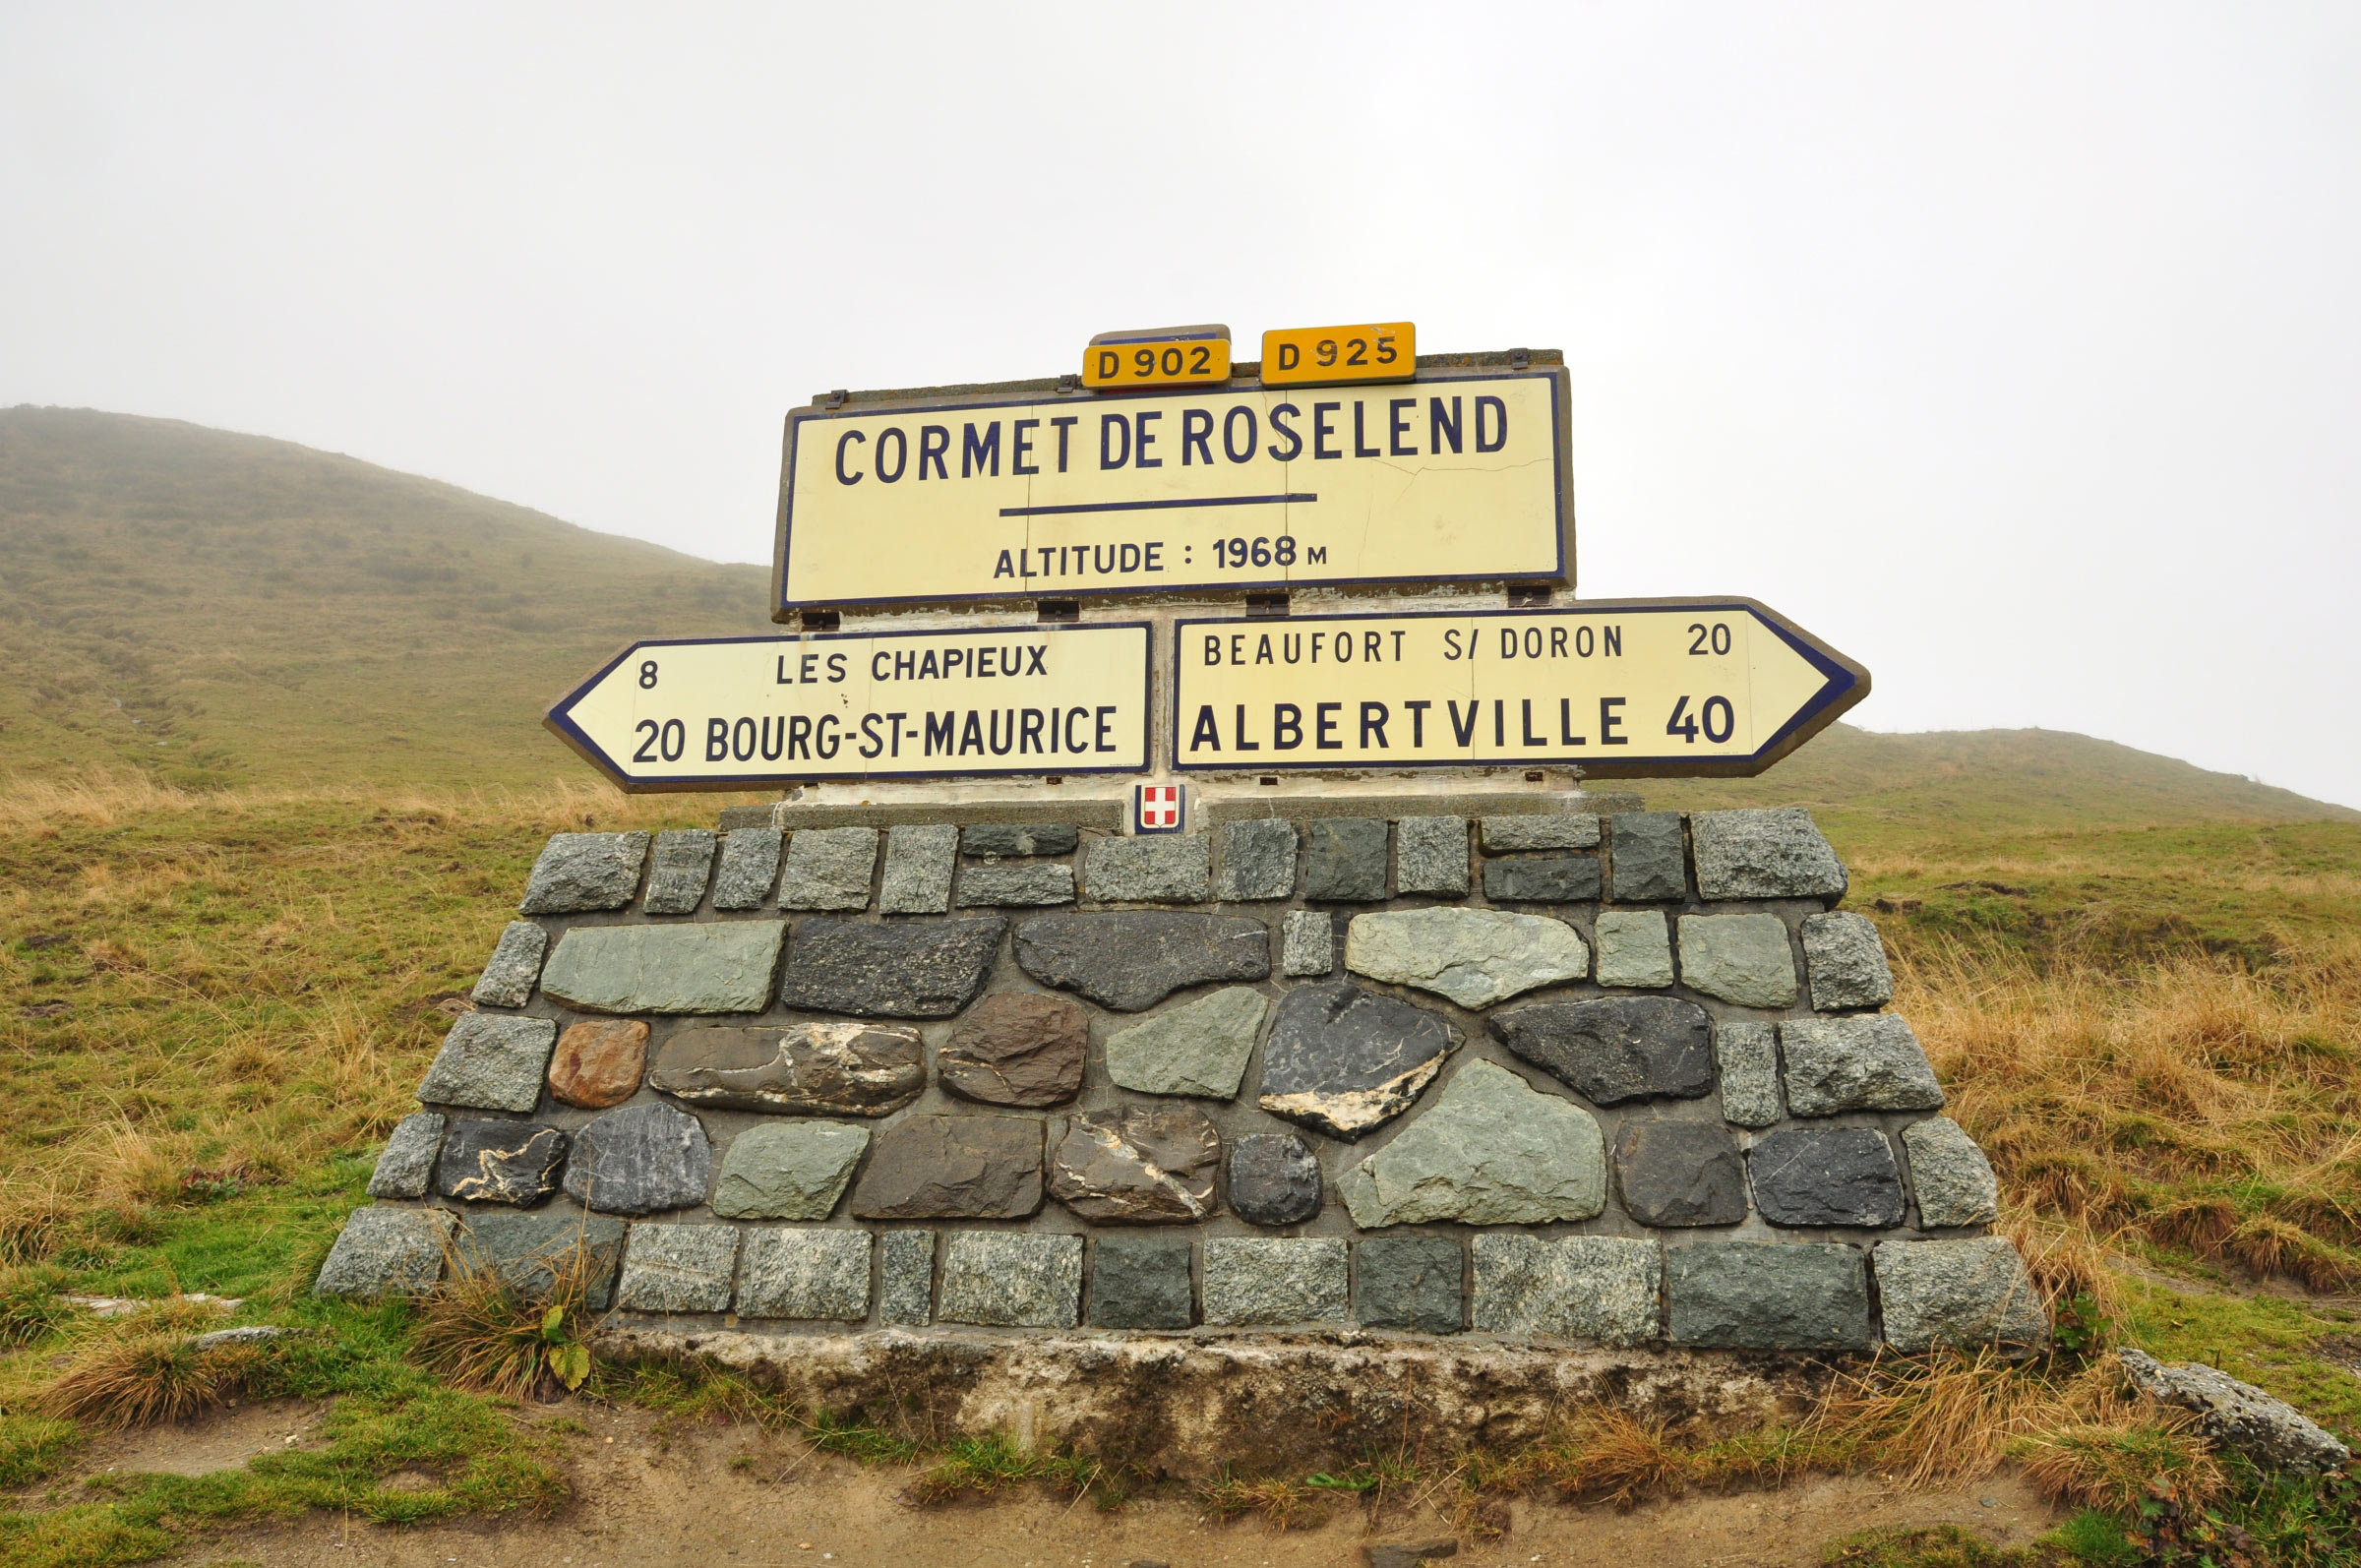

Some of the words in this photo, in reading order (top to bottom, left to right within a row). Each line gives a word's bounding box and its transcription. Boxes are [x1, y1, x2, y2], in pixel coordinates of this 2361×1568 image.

[1099, 351, 1120, 380] D
[1134, 345, 1211, 378] 902
[1278, 343, 1300, 371] D
[1316, 335, 1398, 367] 925
[835, 415, 1078, 486] CORMET
[1100, 410, 1163, 470] DE
[1181, 395, 1508, 466] ROSELEND
[994, 542, 1164, 578] ALTITUDE
[1212, 535, 1297, 569] 1968
[1307, 546, 1327, 566] M
[1204, 631, 1406, 666] BEAUFORT
[1443, 629, 1479, 661] S/
[1500, 626, 1622, 659] DORON
[1687, 623, 1731, 656] 20
[638, 660, 658, 690] 8
[776, 653, 848, 686] LES
[872, 644, 1048, 682] CHAPIEUX
[633, 718, 686, 763] 20
[705, 705, 1118, 762] BOURG-ST-MAURICE
[1189, 696, 1628, 752] ALBERTVILLE
[1665, 694, 1735, 744] 40
